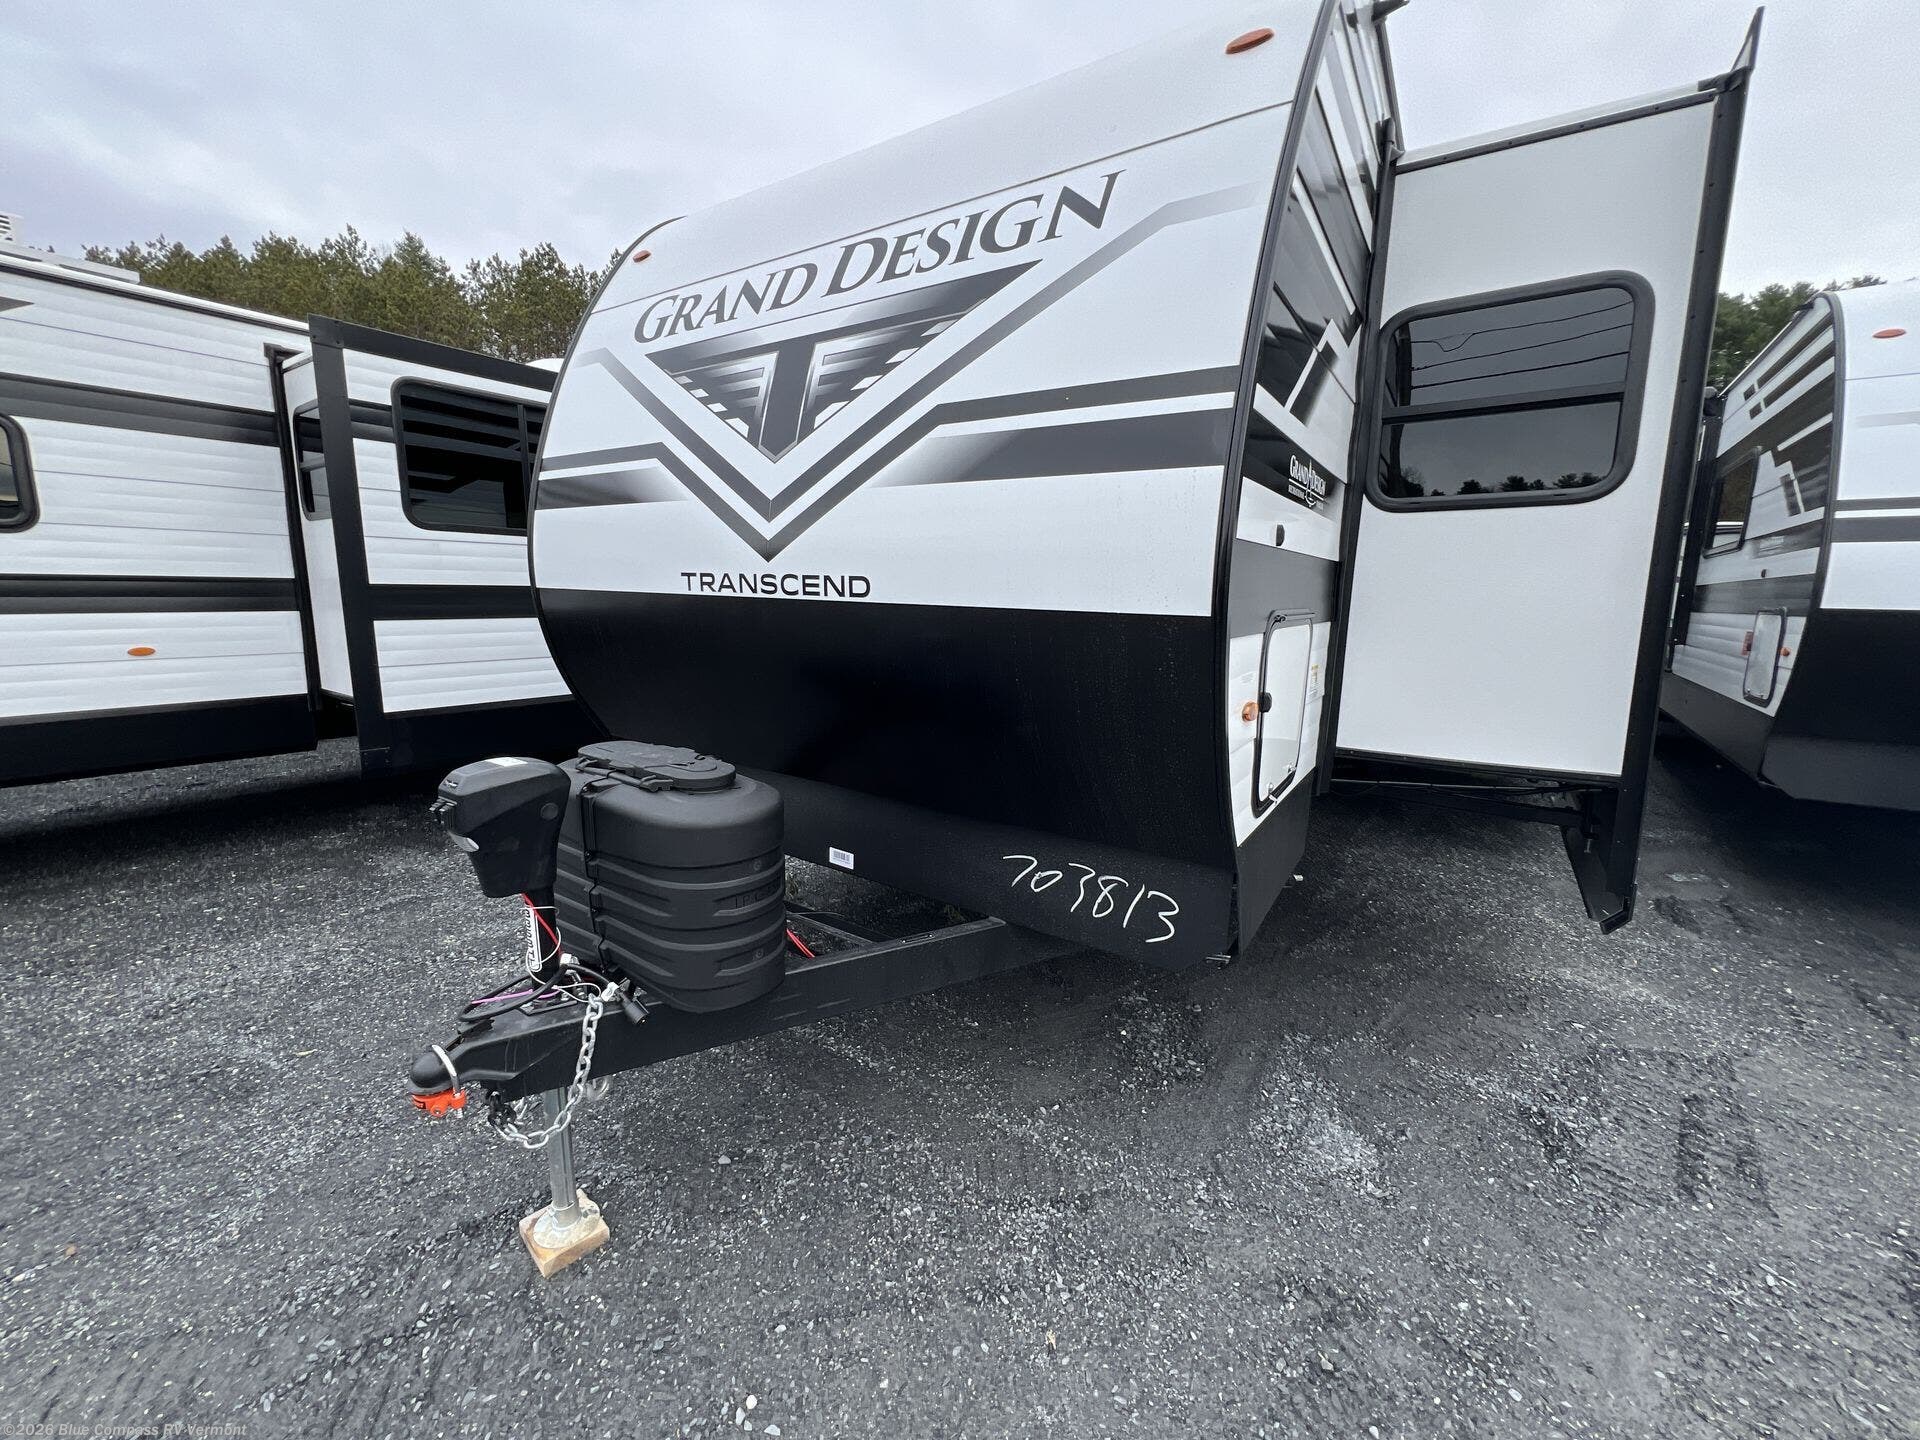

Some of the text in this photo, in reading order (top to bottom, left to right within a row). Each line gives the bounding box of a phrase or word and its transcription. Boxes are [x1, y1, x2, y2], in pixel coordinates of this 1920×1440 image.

[633, 168, 1127, 345] GRAND DESIGN
[680, 572, 872, 599] TRANSCEND
[1002, 854, 1180, 943] 703813
